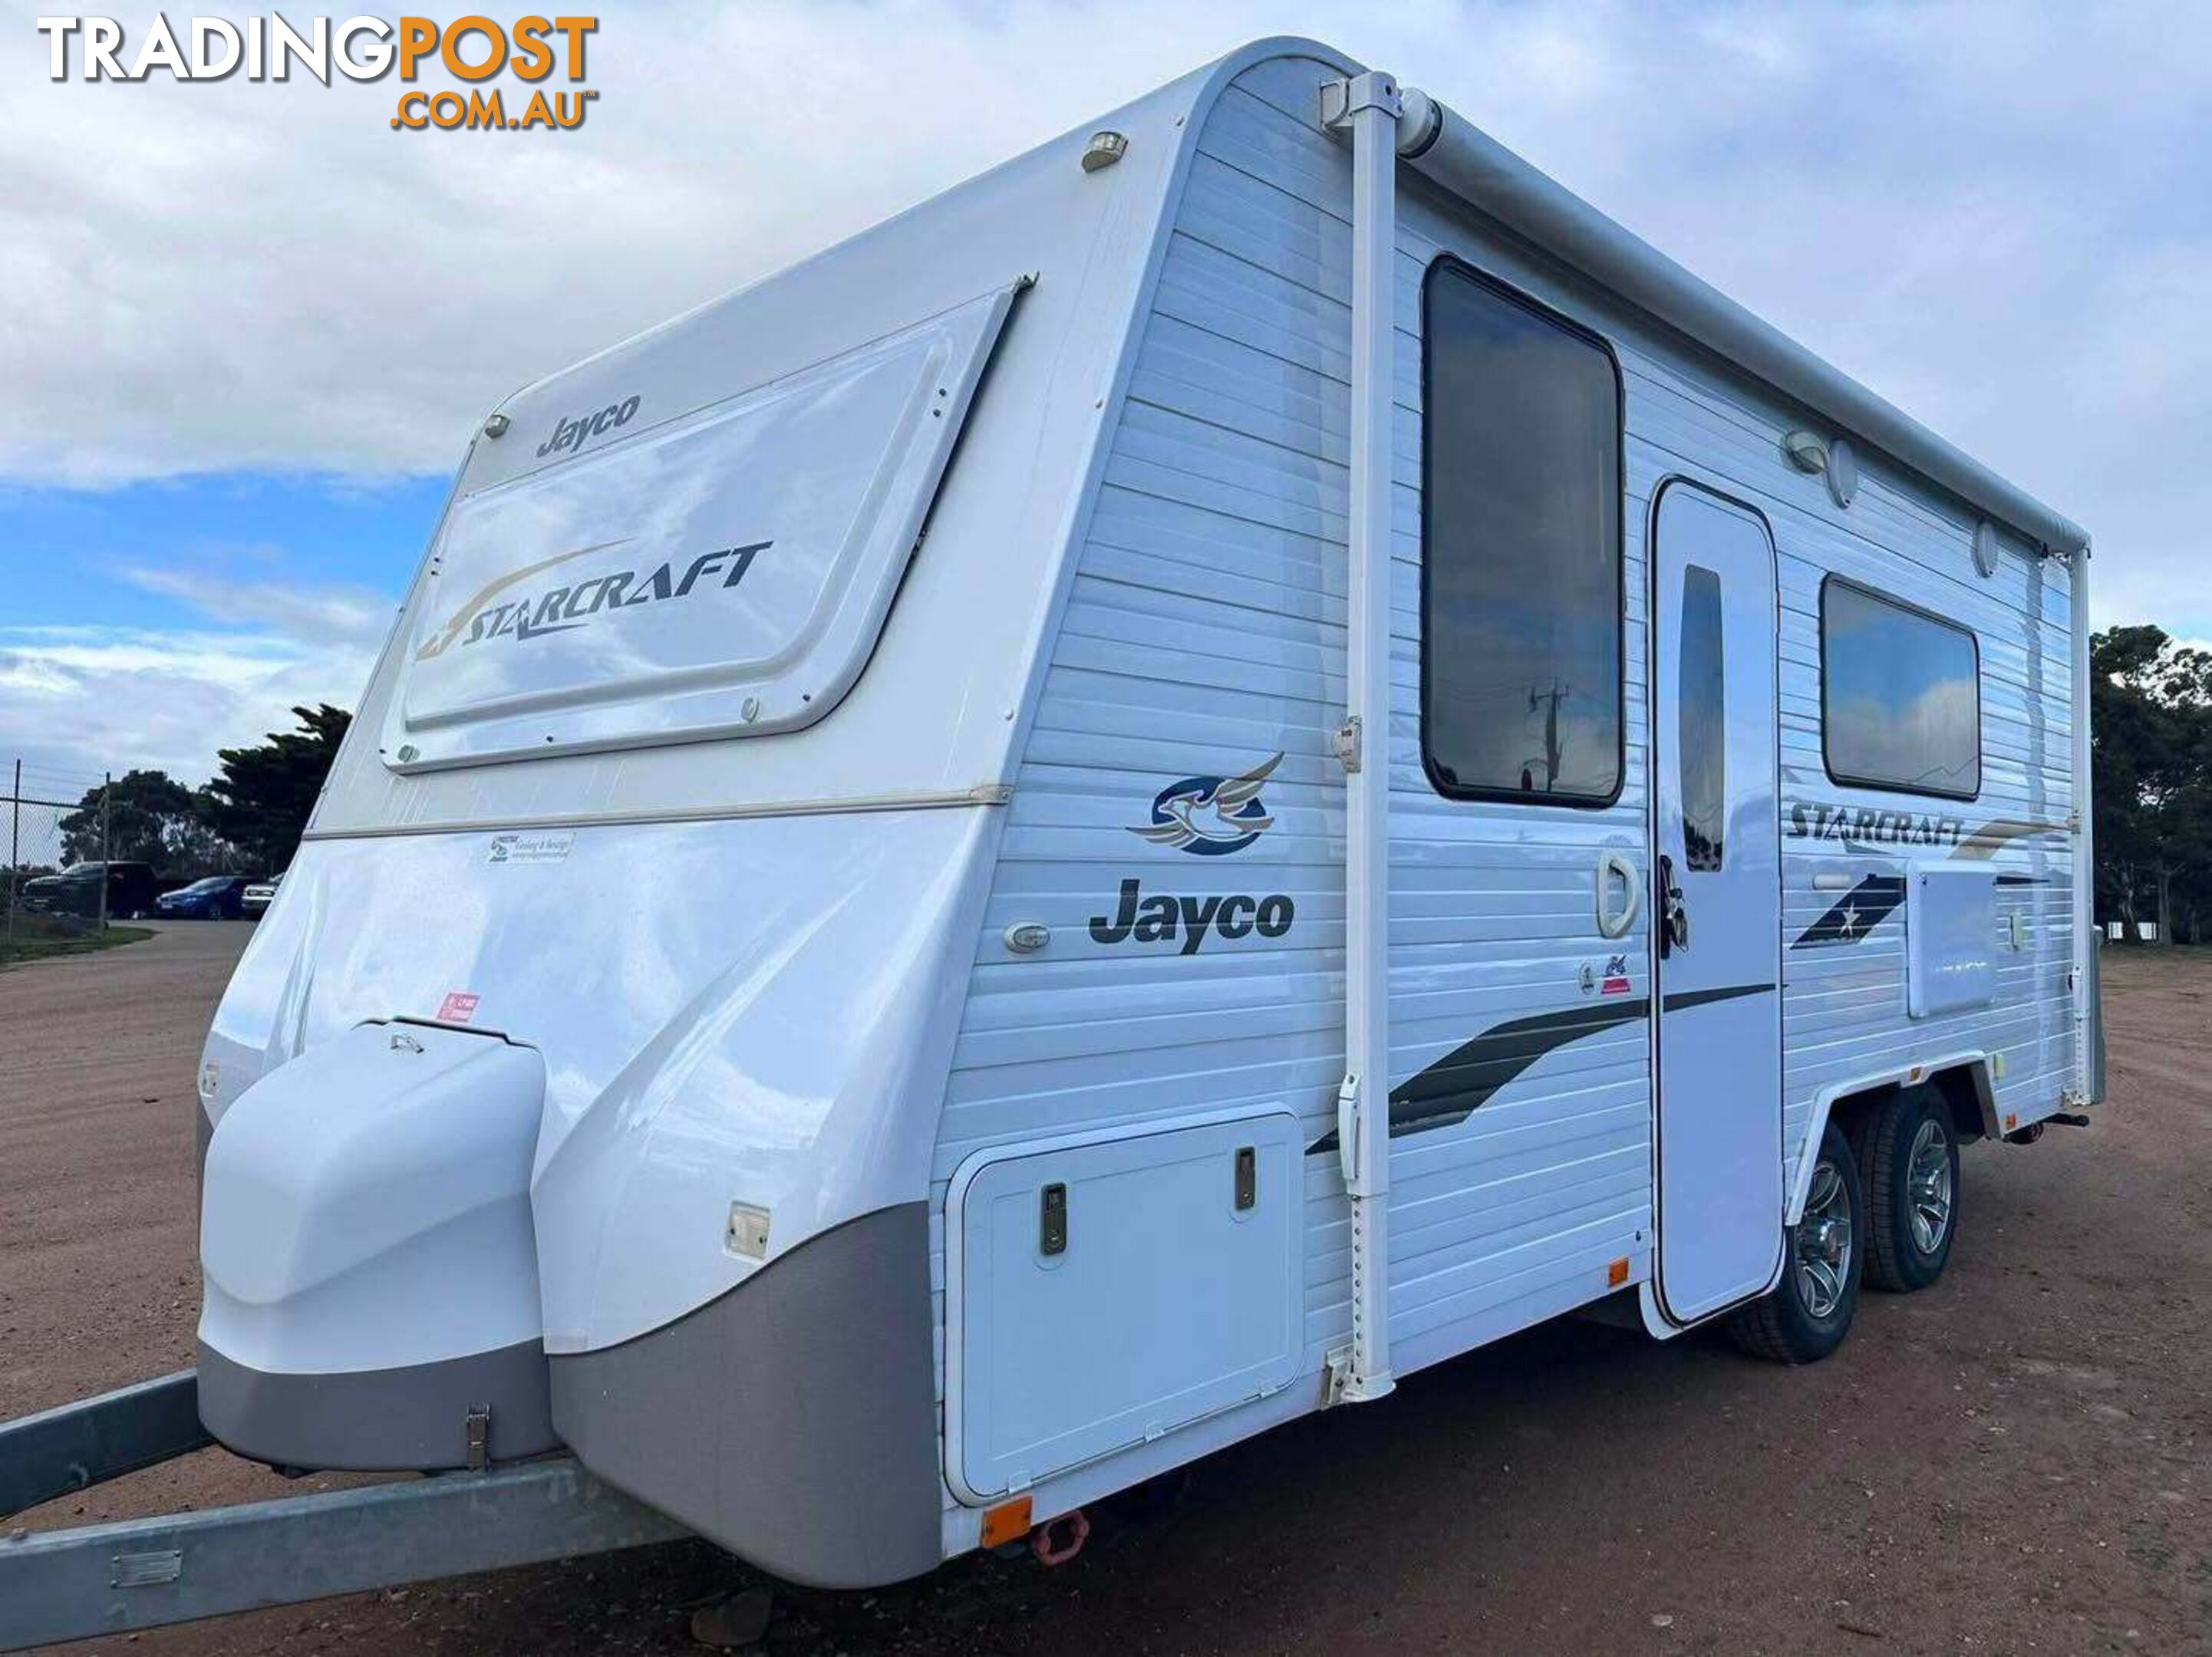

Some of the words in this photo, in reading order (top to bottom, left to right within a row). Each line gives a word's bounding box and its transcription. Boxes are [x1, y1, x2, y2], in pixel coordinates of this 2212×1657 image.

[537, 395, 641, 457] Jayco
[462, 540, 774, 646] STARCRAFT
[1786, 802, 1965, 847] STARCRAFT
[1089, 879, 1294, 956] Jayco
